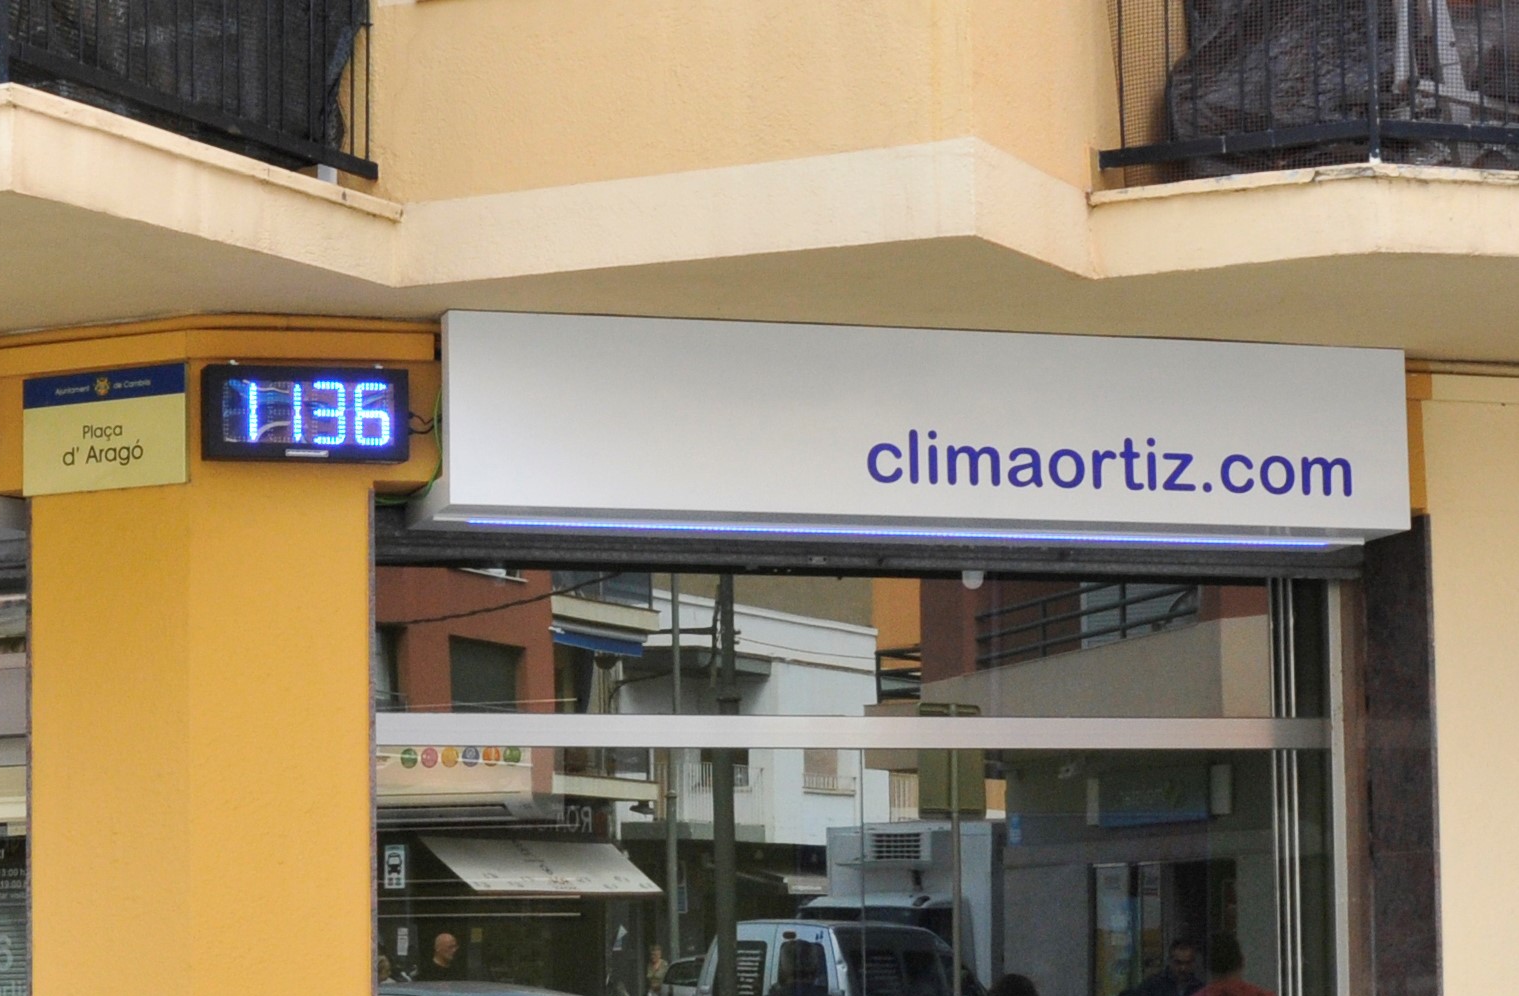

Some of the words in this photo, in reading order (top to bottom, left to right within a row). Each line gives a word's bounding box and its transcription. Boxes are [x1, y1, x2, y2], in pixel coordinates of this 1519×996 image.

[82, 424, 123, 441] Plaça
[85, 439, 144, 466] Aragó
[866, 429, 1353, 497] climaortiz.com
